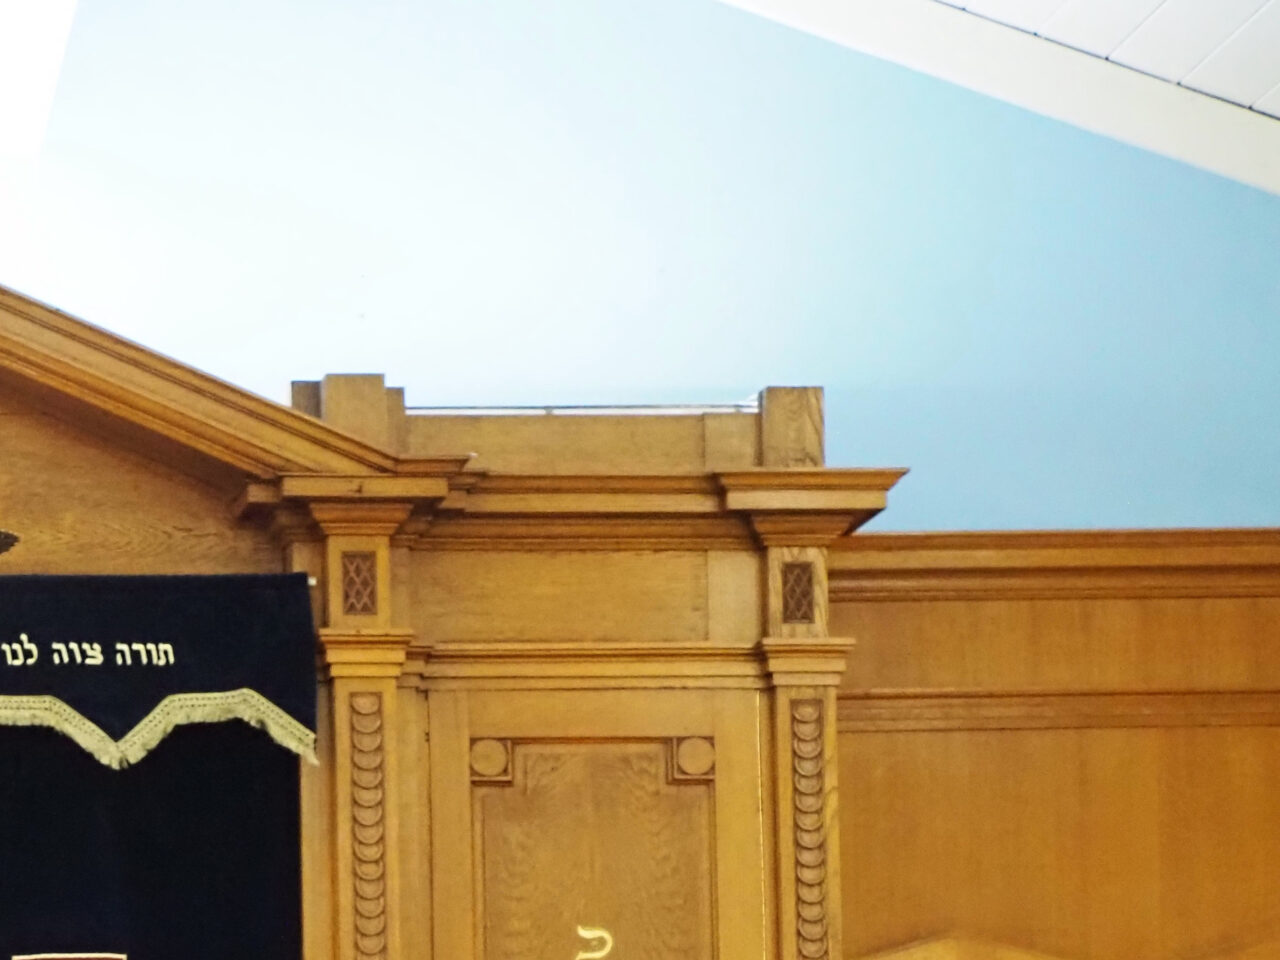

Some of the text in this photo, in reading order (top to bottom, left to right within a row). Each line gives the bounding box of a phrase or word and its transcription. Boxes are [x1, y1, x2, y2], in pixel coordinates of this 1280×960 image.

[0, 632, 39, 666] לנו
[51, 641, 105, 666] צוה
[115, 642, 175, 667] תורה
